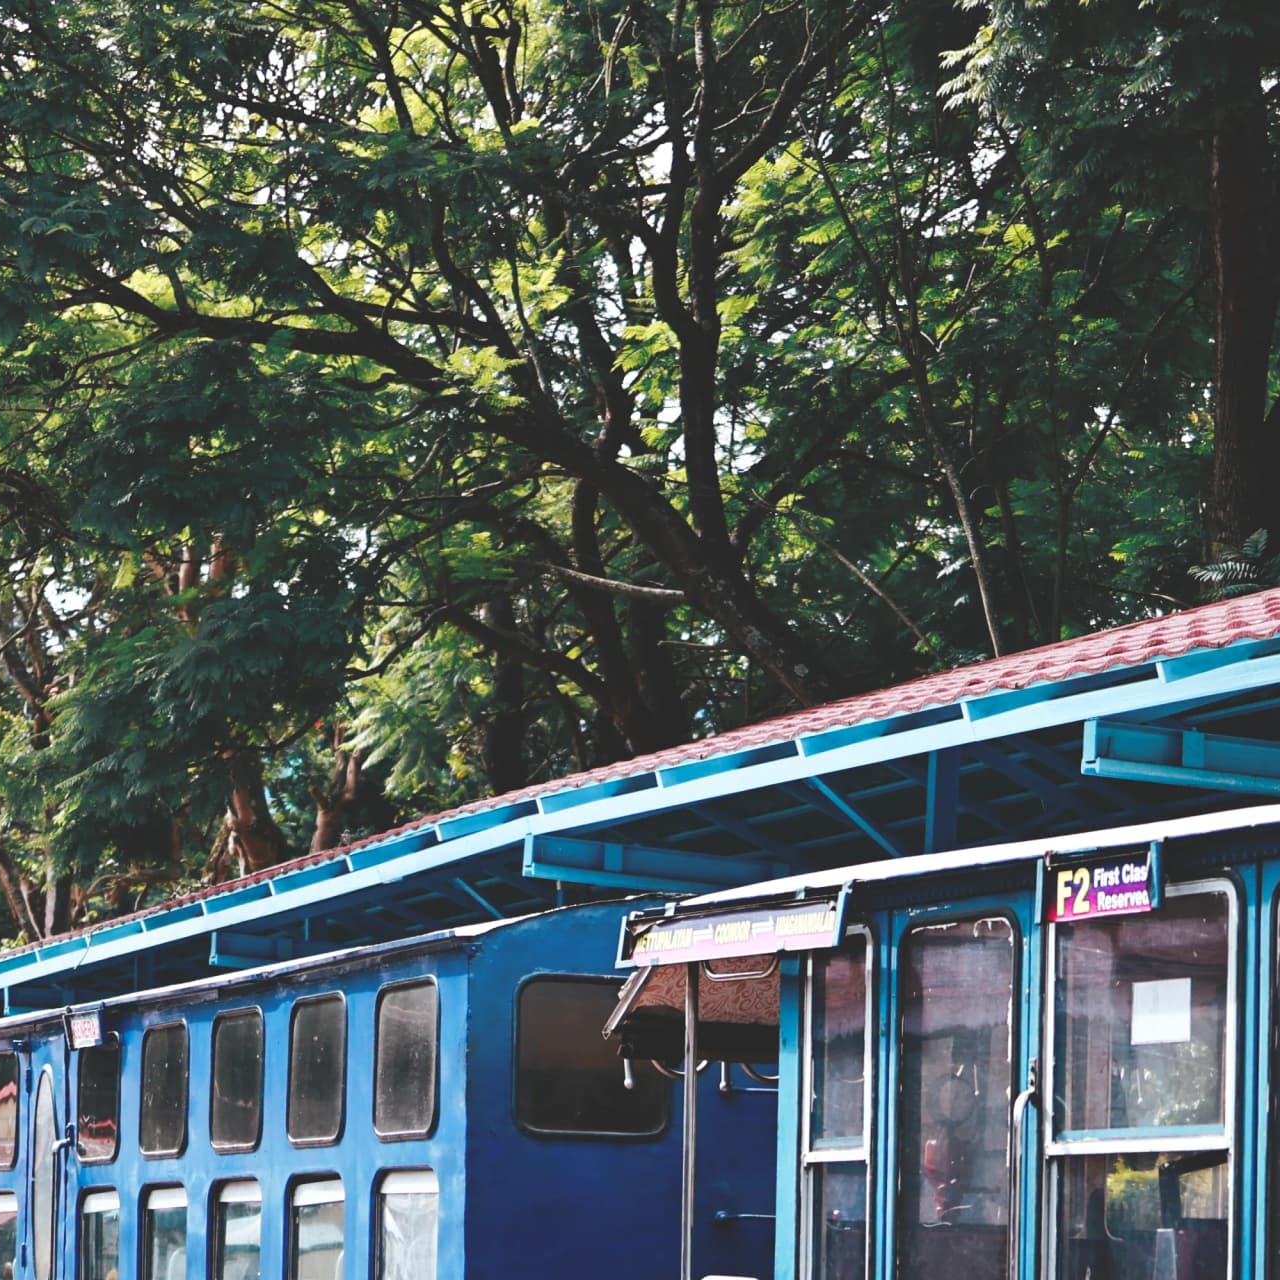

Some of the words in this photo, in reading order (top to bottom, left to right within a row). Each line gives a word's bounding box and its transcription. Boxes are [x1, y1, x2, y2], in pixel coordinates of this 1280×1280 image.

[1056, 867, 1090, 916] F2
[1093, 866, 1120, 888] First
[1122, 863, 1147, 884] Clas
